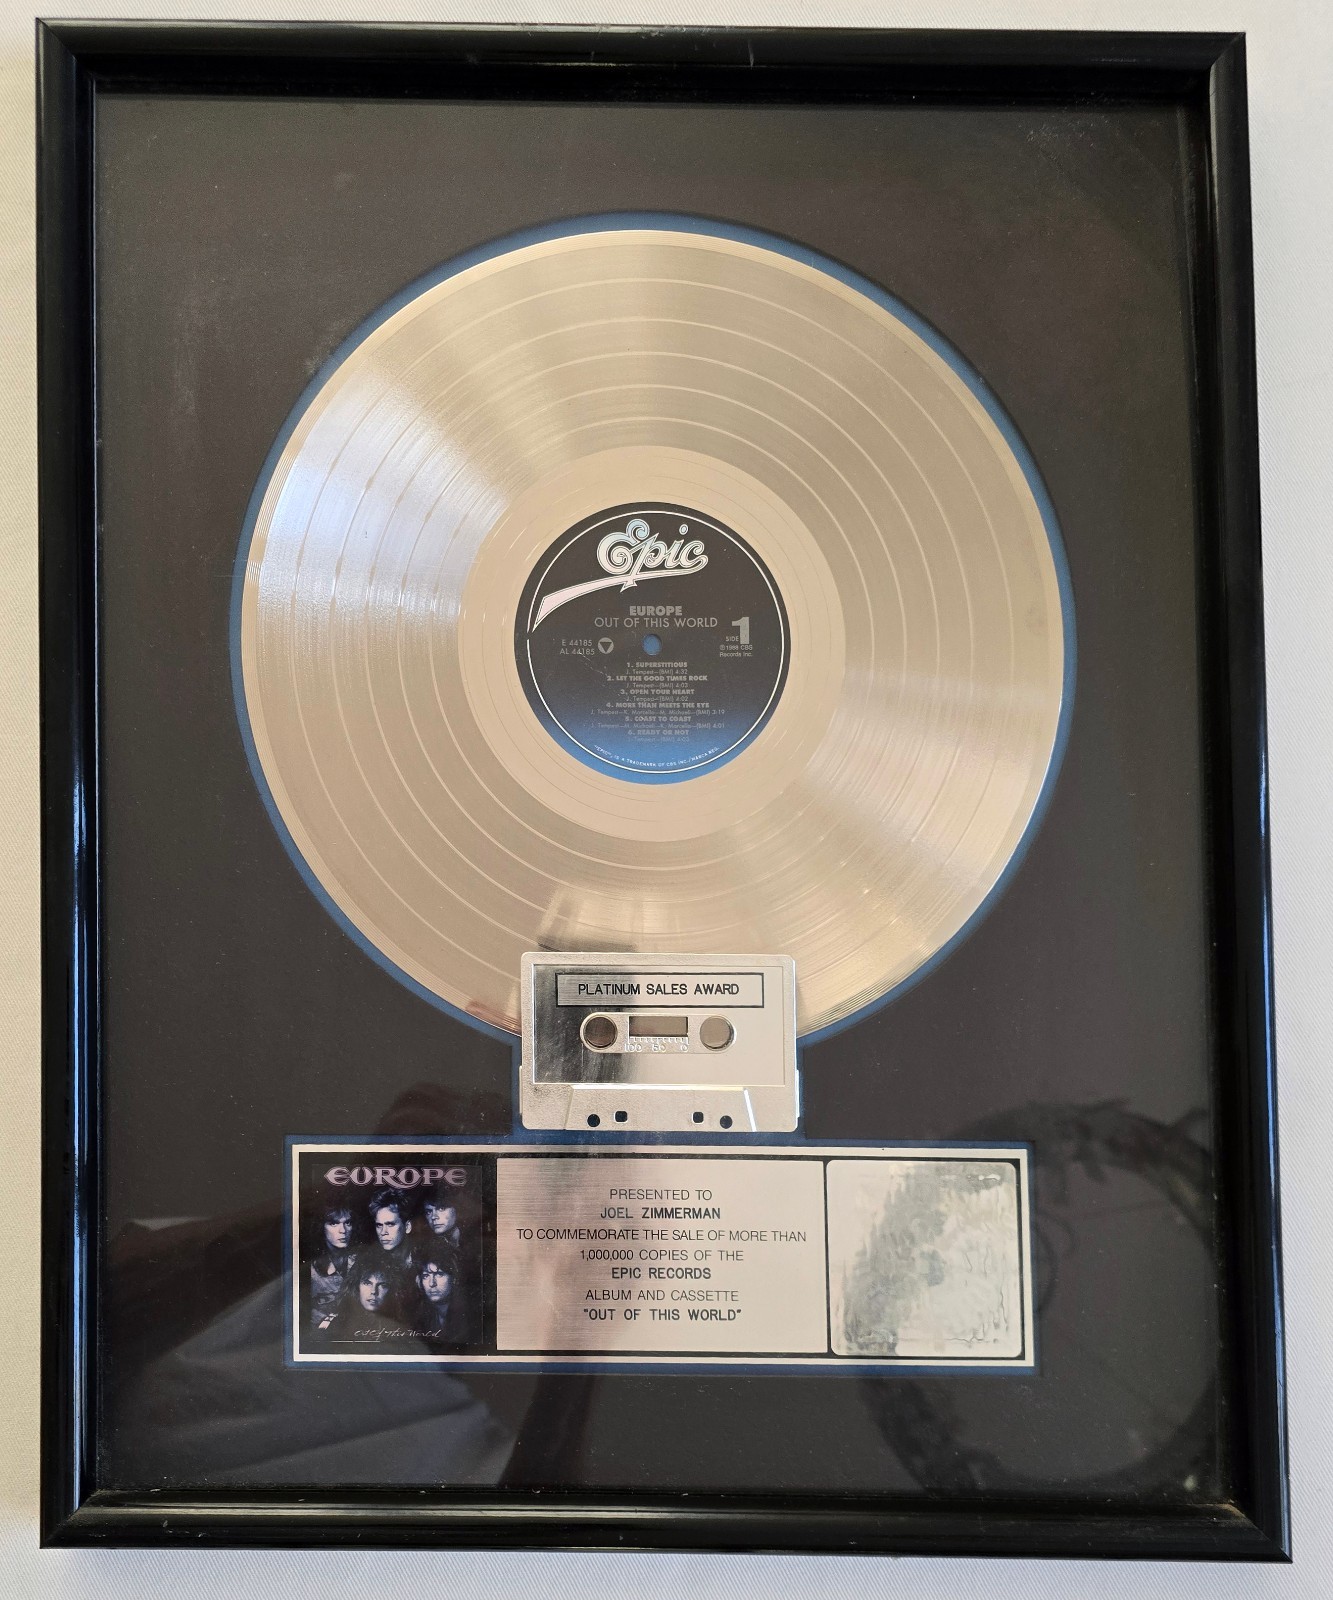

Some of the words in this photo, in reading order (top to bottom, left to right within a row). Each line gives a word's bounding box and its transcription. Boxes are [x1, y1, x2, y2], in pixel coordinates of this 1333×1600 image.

[629, 605, 683, 616] EUROPE
[594, 617, 620, 628] OUT
[623, 617, 640, 628] OF
[643, 617, 670, 628] THIS
[674, 617, 718, 628] WORLD
[731, 616, 750, 645] 1
[561, 639, 567, 647] E
[569, 639, 593, 647] 44185
[571, 648, 595, 656] 44185
[626, 758, 656, 767] TRADEMARK
[578, 983, 641, 995] PLATINUM
[646, 983, 688, 995] SALES
[693, 983, 740, 995] AWARD
[624, 1043, 643, 1052] 100
[652, 1043, 667, 1052] 50
[324, 1166, 468, 1189] EUROPE
[609, 1189, 690, 1201] PRESENTED
[695, 1189, 712, 1201] TO
[600, 1207, 634, 1219] JOEL
[641, 1207, 721, 1220] ZIMMERMAN
[516, 1228, 533, 1240] TO
[536, 1228, 639, 1241] COMMEMORATE
[643, 1229, 669, 1241] THE
[672, 1230, 704, 1241] SALE
[707, 1230, 726, 1241] OF
[729, 1230, 768, 1242] MORE
[771, 1231, 807, 1242] THAN
[639, 1250, 689, 1262] COPIES
[694, 1250, 712, 1262] OF
[718, 1250, 744, 1262] THE
[611, 1268, 642, 1280] EPIC
[648, 1268, 712, 1280] RECORDS
[585, 1290, 632, 1302] ALBUM
[637, 1290, 666, 1302] AND
[670, 1290, 739, 1302] CASSETTE
[584, 1309, 616, 1321] "OUT
[624, 1309, 642, 1321] OF
[650, 1309, 680, 1321] THIS
[687, 1309, 742, 1321] WORLD"
